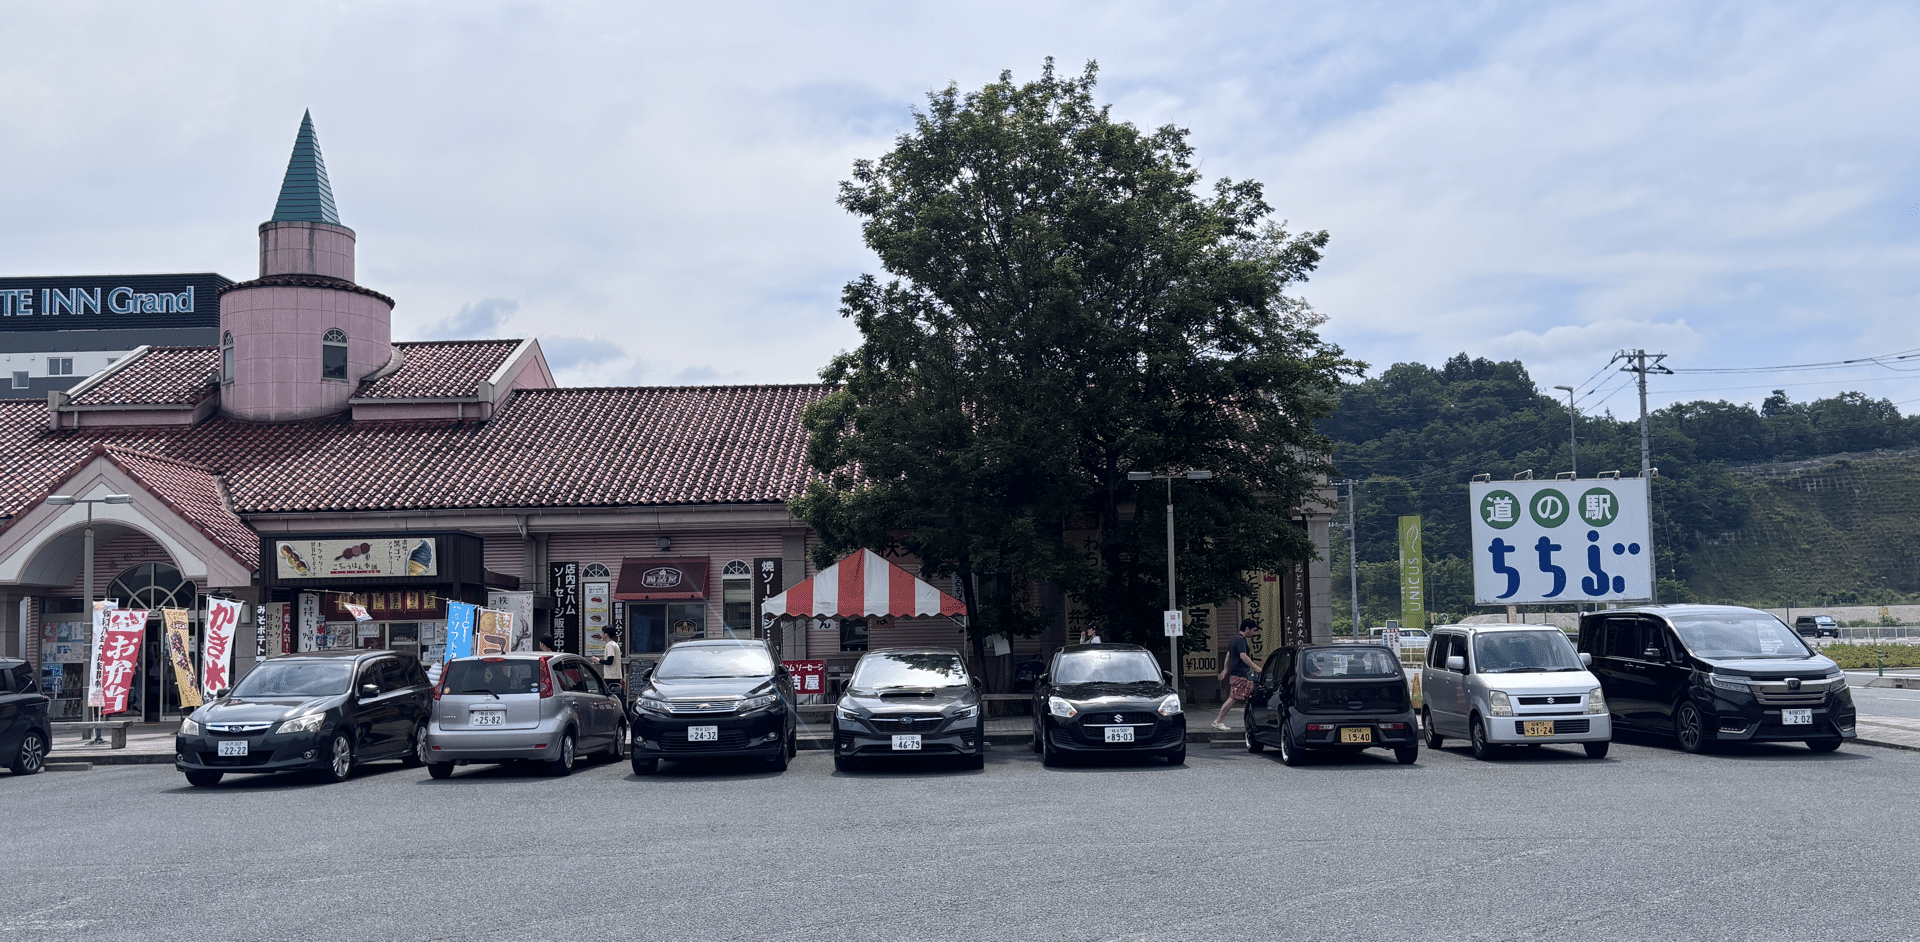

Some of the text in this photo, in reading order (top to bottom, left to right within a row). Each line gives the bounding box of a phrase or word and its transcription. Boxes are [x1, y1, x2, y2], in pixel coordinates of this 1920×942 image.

[41, 288, 101, 315] INN
[107, 286, 195, 314] Grand
[1485, 492, 1612, 523] 道の駅
[1488, 530, 1640, 599] ちちぶ
[565, 564, 576, 615] 店内でハム
[1408, 558, 1420, 611] UNICUS
[257, 605, 266, 655] みそポテト
[303, 595, 314, 651] お持ち帰り
[205, 603, 235, 691] かき氷
[103, 635, 139, 712] お弁当
[480, 716, 501, 724] 25-82
[225, 747, 246, 755] 22-22
[695, 732, 716, 740] 24-32
[899, 740, 920, 749] 46-79
[1112, 733, 1133, 741] 89-03
[1349, 733, 1370, 741] 19-40
